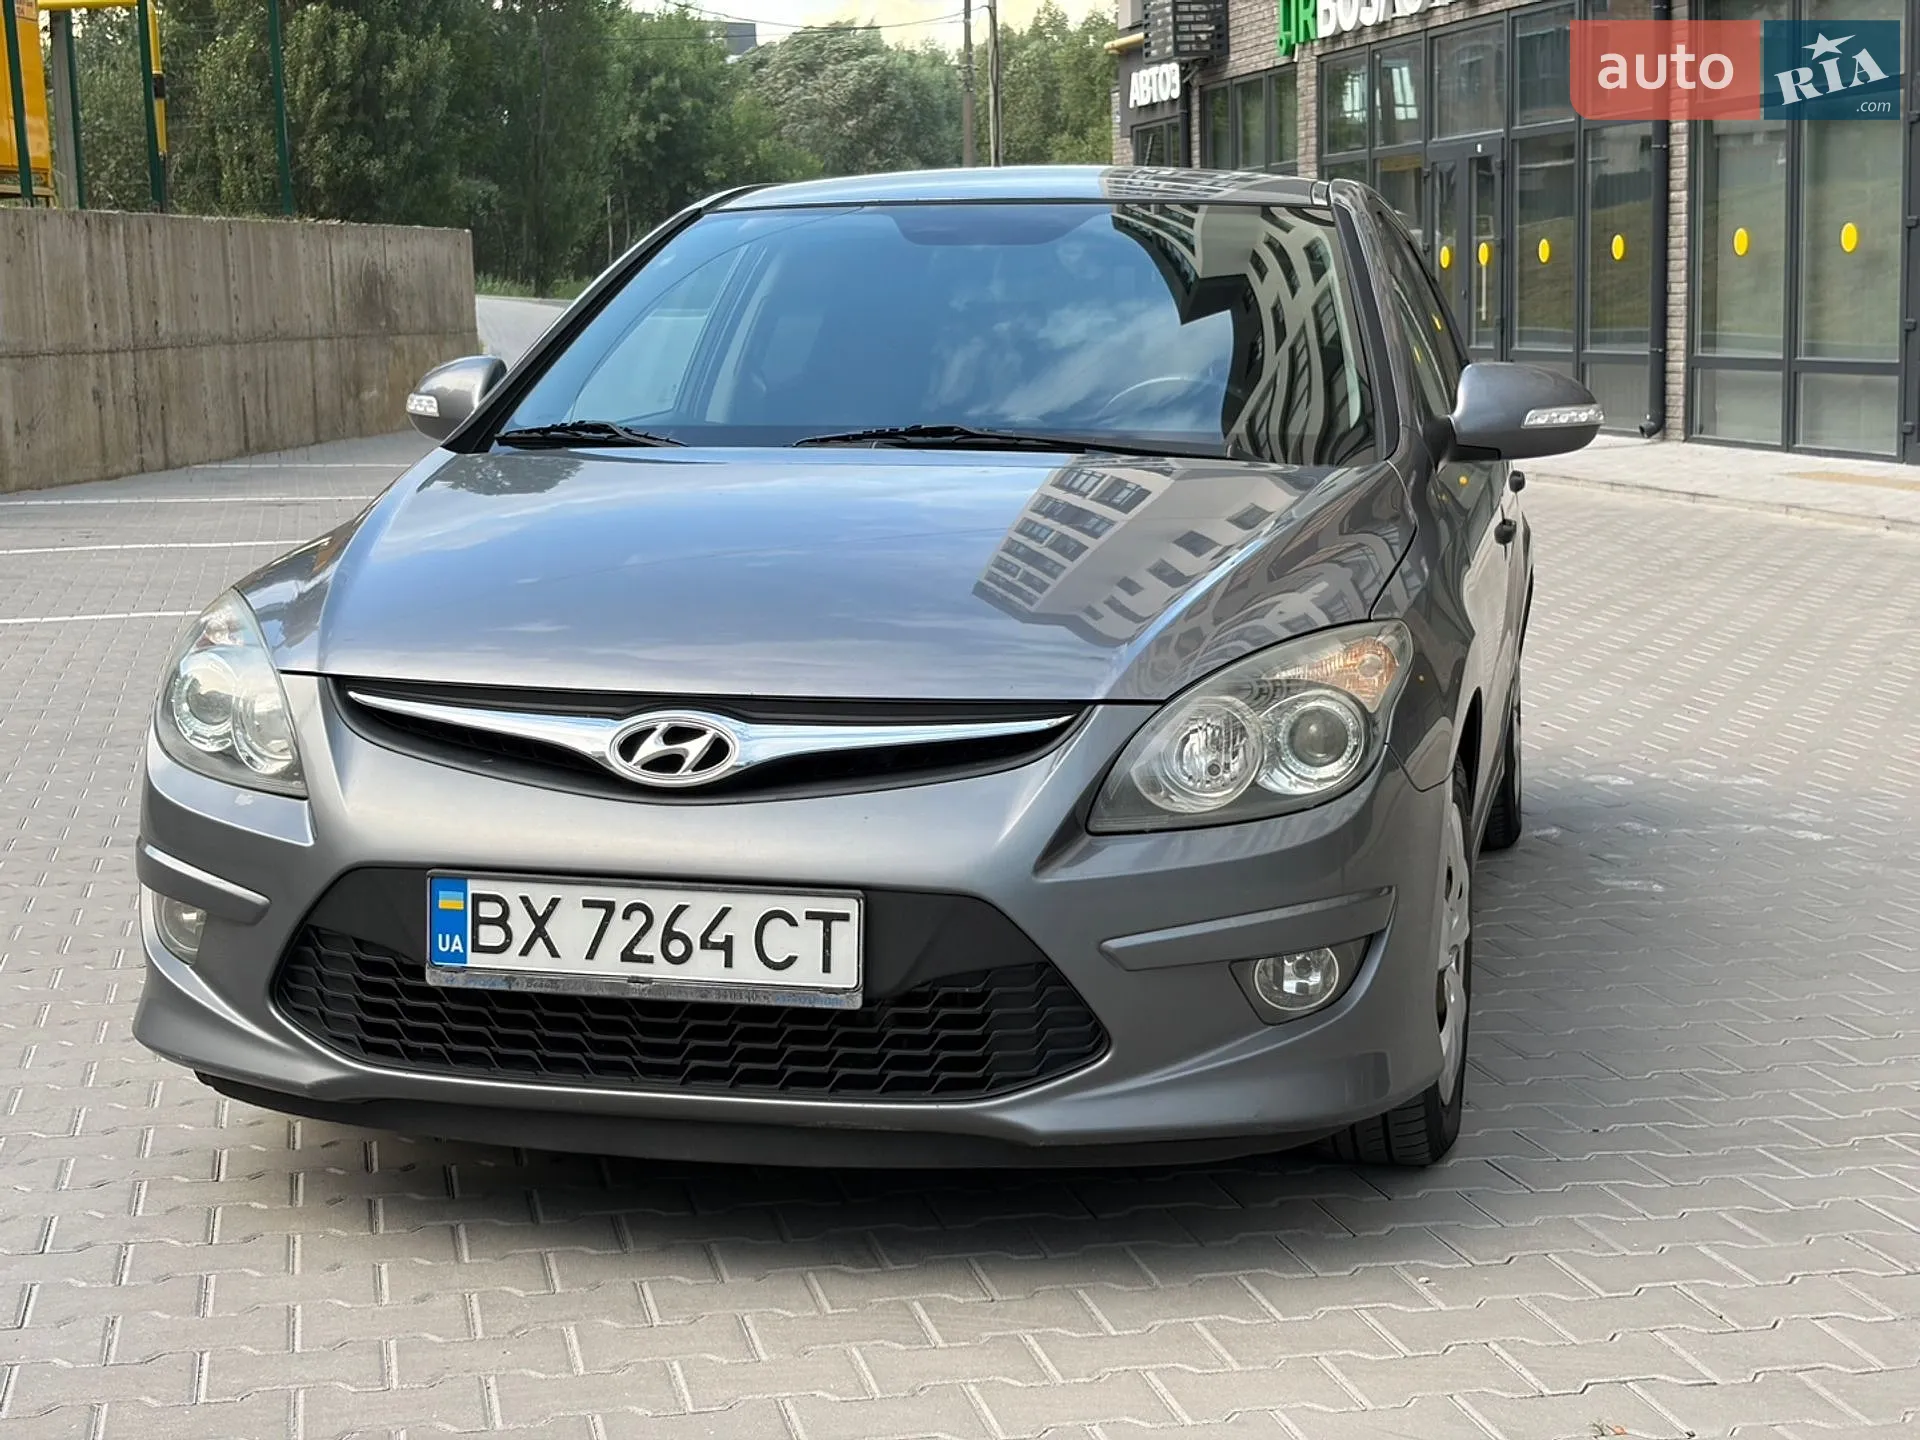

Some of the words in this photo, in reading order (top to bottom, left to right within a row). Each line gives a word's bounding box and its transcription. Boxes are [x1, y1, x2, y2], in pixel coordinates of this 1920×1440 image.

[438, 933, 464, 954] UA
[470, 892, 561, 958] BX
[581, 898, 734, 969] 7264
[754, 908, 850, 974] CT
